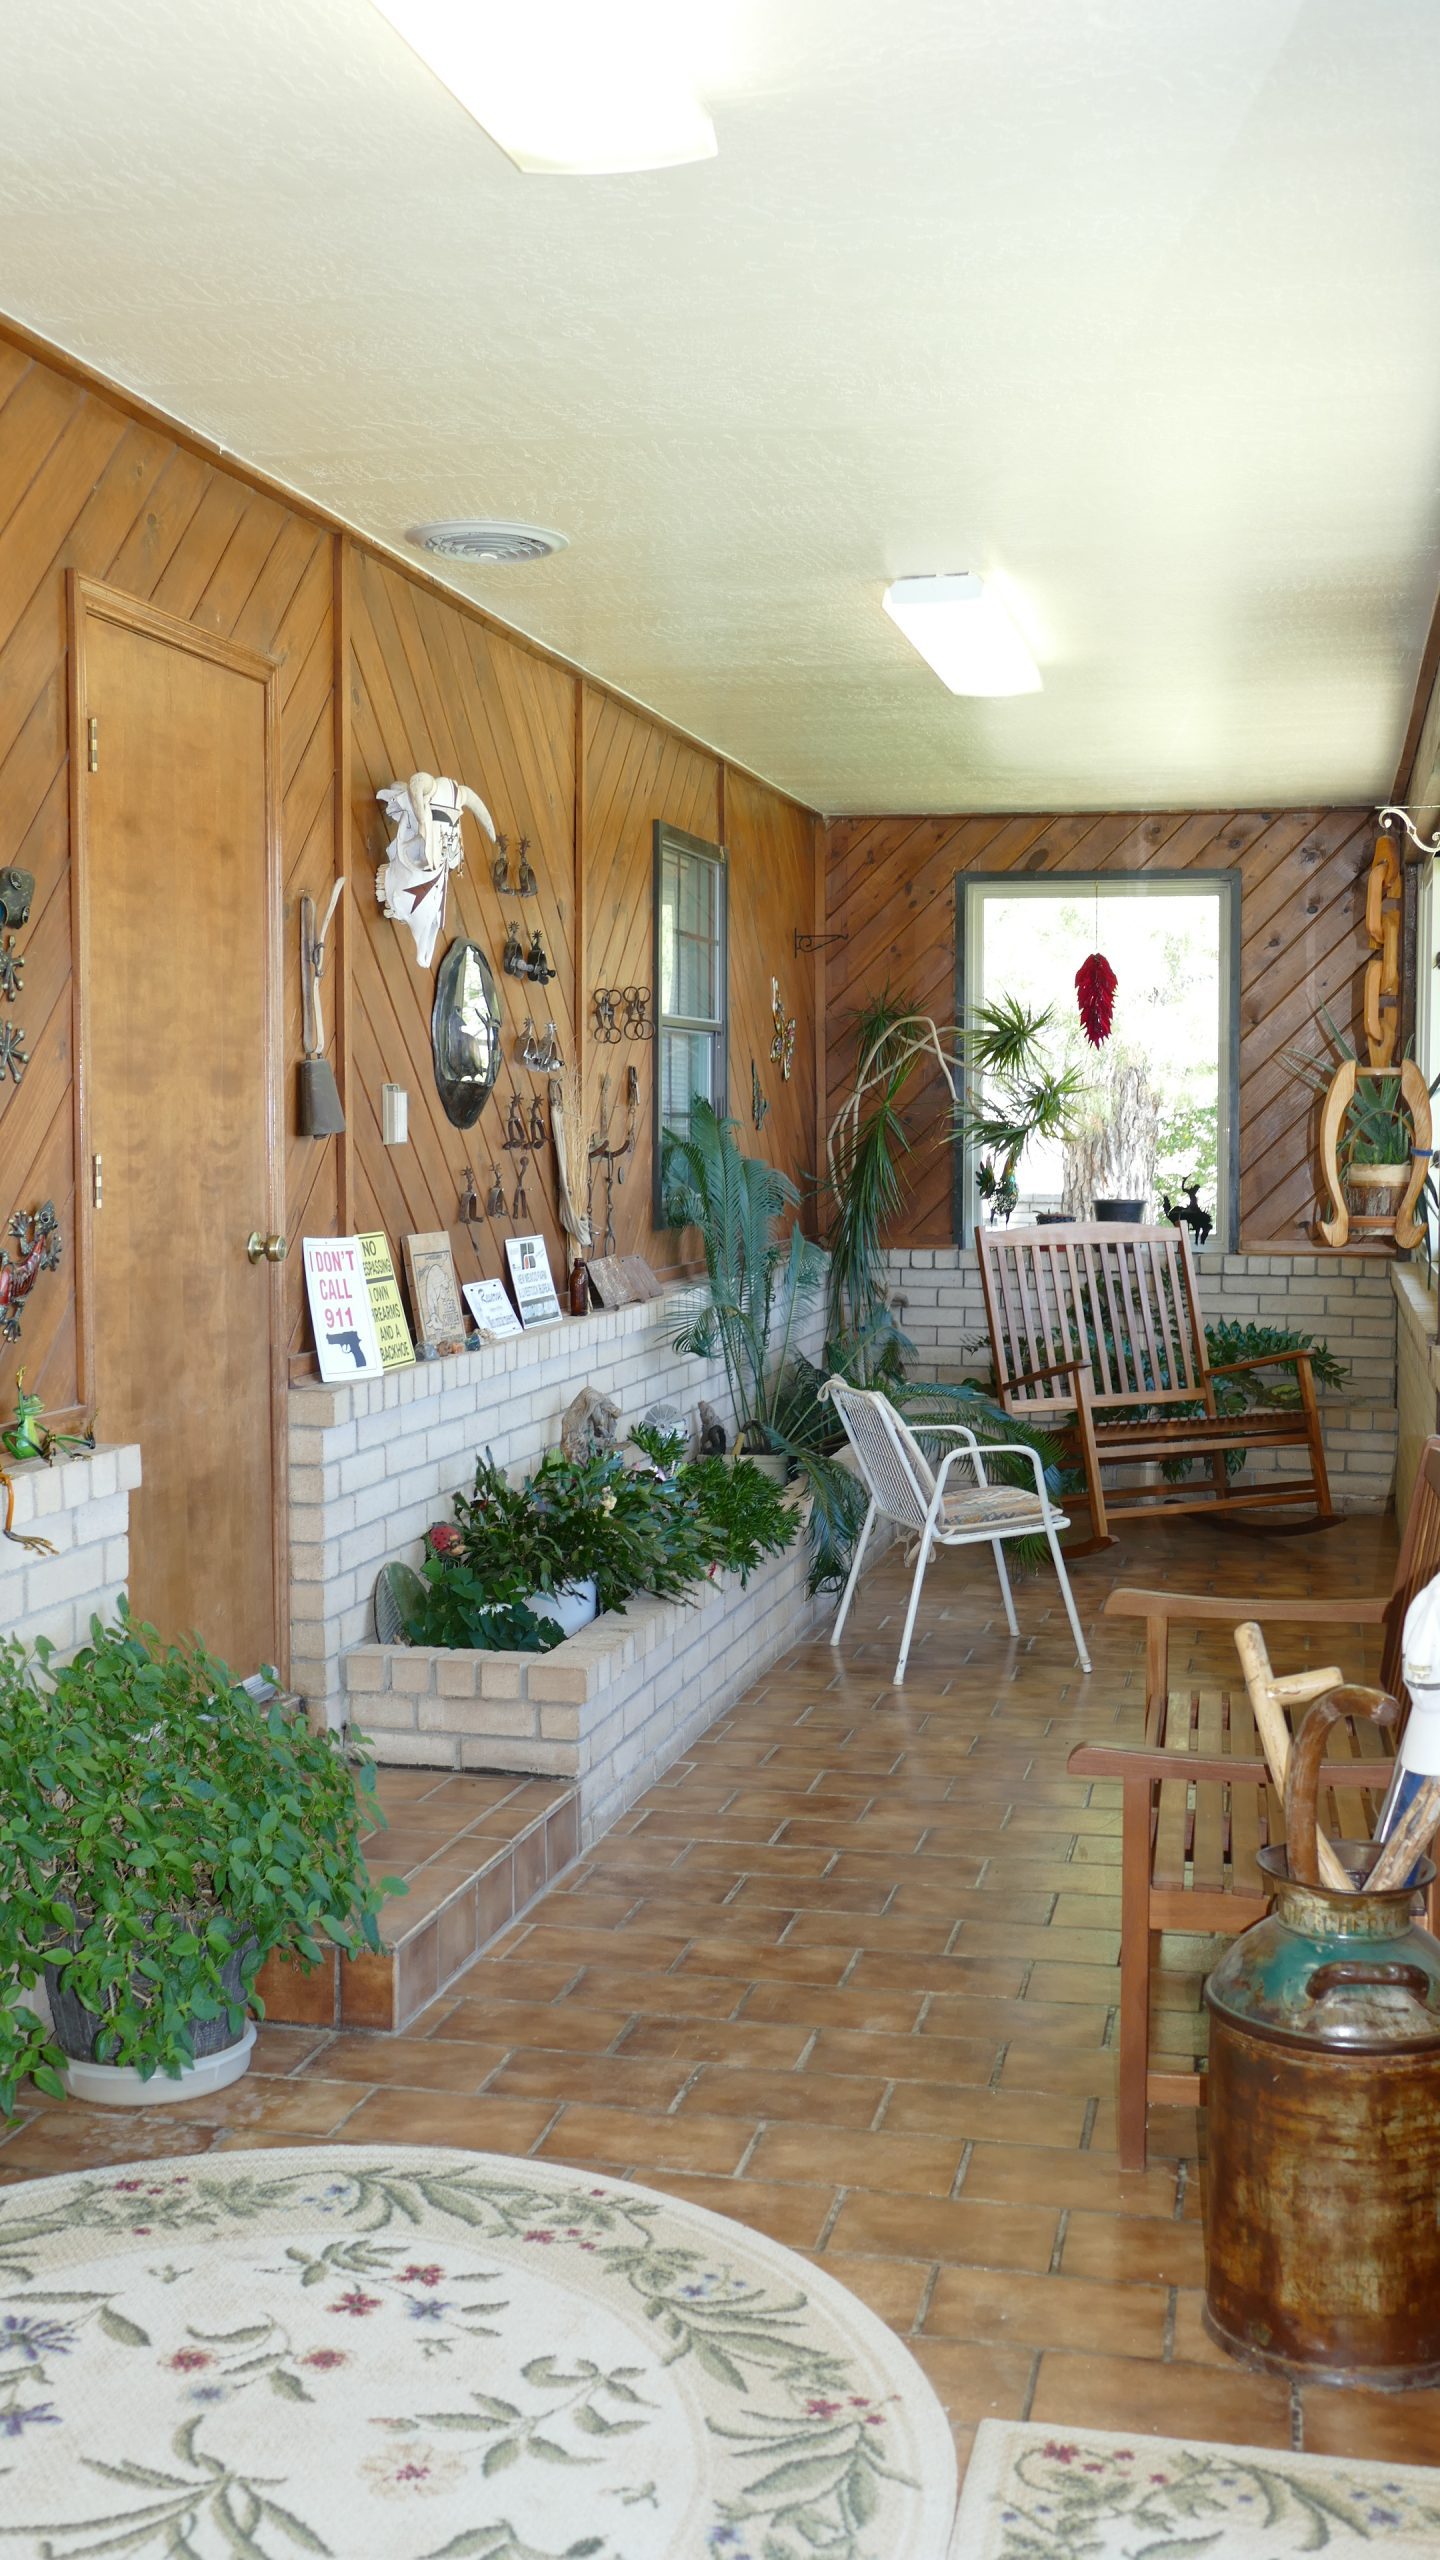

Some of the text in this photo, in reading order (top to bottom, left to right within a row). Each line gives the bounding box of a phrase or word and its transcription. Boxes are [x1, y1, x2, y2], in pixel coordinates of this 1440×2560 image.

[362, 1241, 376, 1257] NO
[316, 1251, 354, 1272] DON'T
[363, 1258, 391, 1276] ESPASSING
[320, 1278, 352, 1300] CALL
[374, 1286, 390, 1302] OWN
[325, 1307, 353, 1328] 911
[372, 1304, 401, 1322] IREARMS
[380, 1323, 402, 1341] AND A
[380, 1342, 410, 1362] BACKHOE
